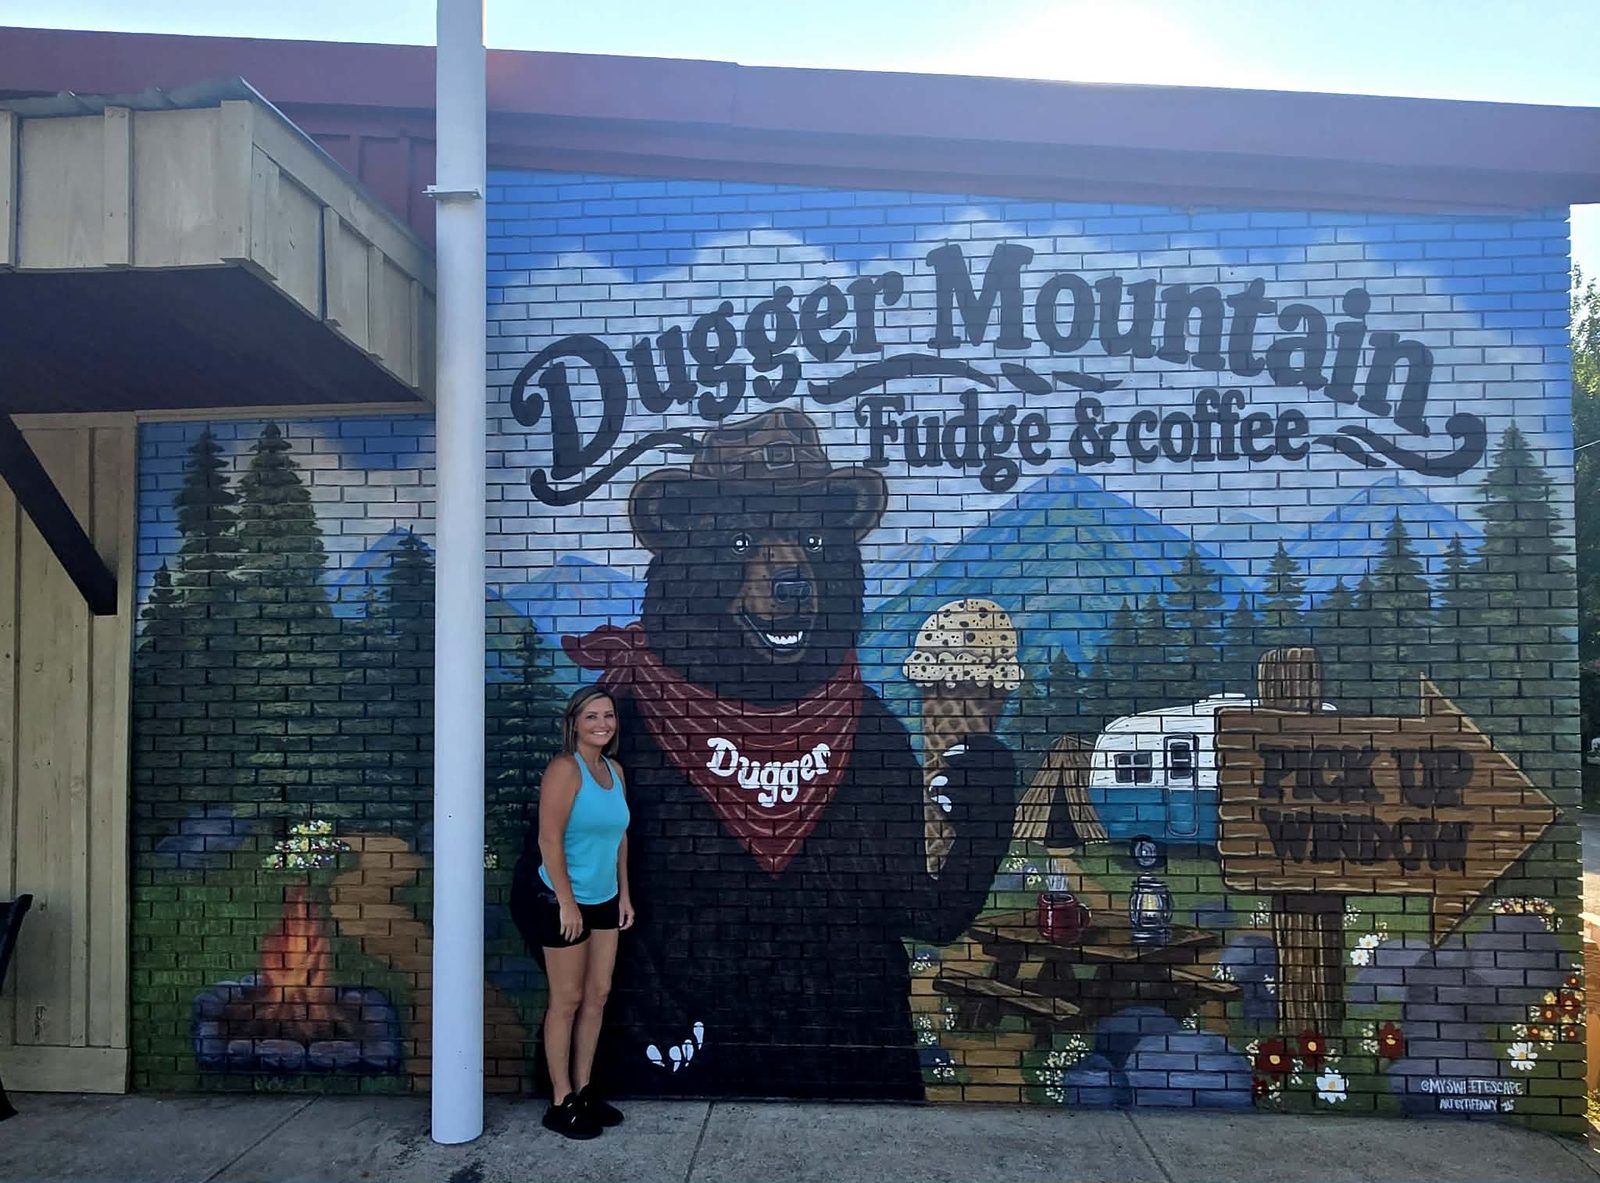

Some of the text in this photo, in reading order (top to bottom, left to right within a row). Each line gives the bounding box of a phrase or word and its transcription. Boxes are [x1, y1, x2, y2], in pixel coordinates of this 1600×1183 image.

[511, 243, 1435, 482] Dugger Mountain
[855, 388, 1310, 493] Fudge & coffee
[706, 737, 831, 808] Dugger
[1258, 743, 1474, 809] PICK UP
[1258, 807, 1474, 872] WINDOW
